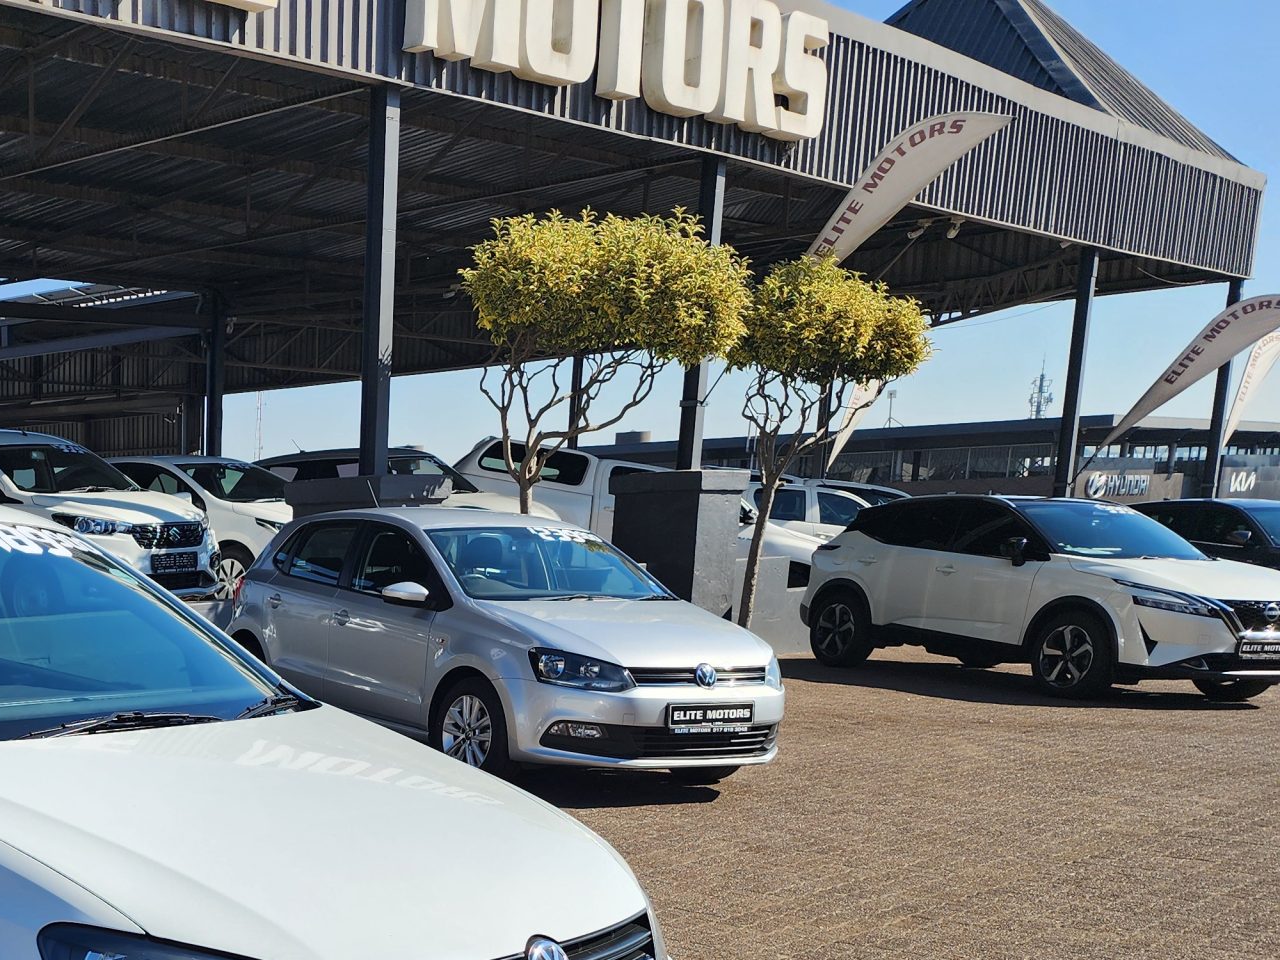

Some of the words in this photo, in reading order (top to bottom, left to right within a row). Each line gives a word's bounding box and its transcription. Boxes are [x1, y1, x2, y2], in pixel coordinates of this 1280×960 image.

[862, 119, 966, 194] MOTORS
[1163, 344, 1205, 385] ELITE
[1107, 474, 1150, 496] HYUNDAI
[1242, 644, 1262, 652] ELITE
[673, 710, 703, 720] ELITE
[706, 708, 751, 719] MOTORS
